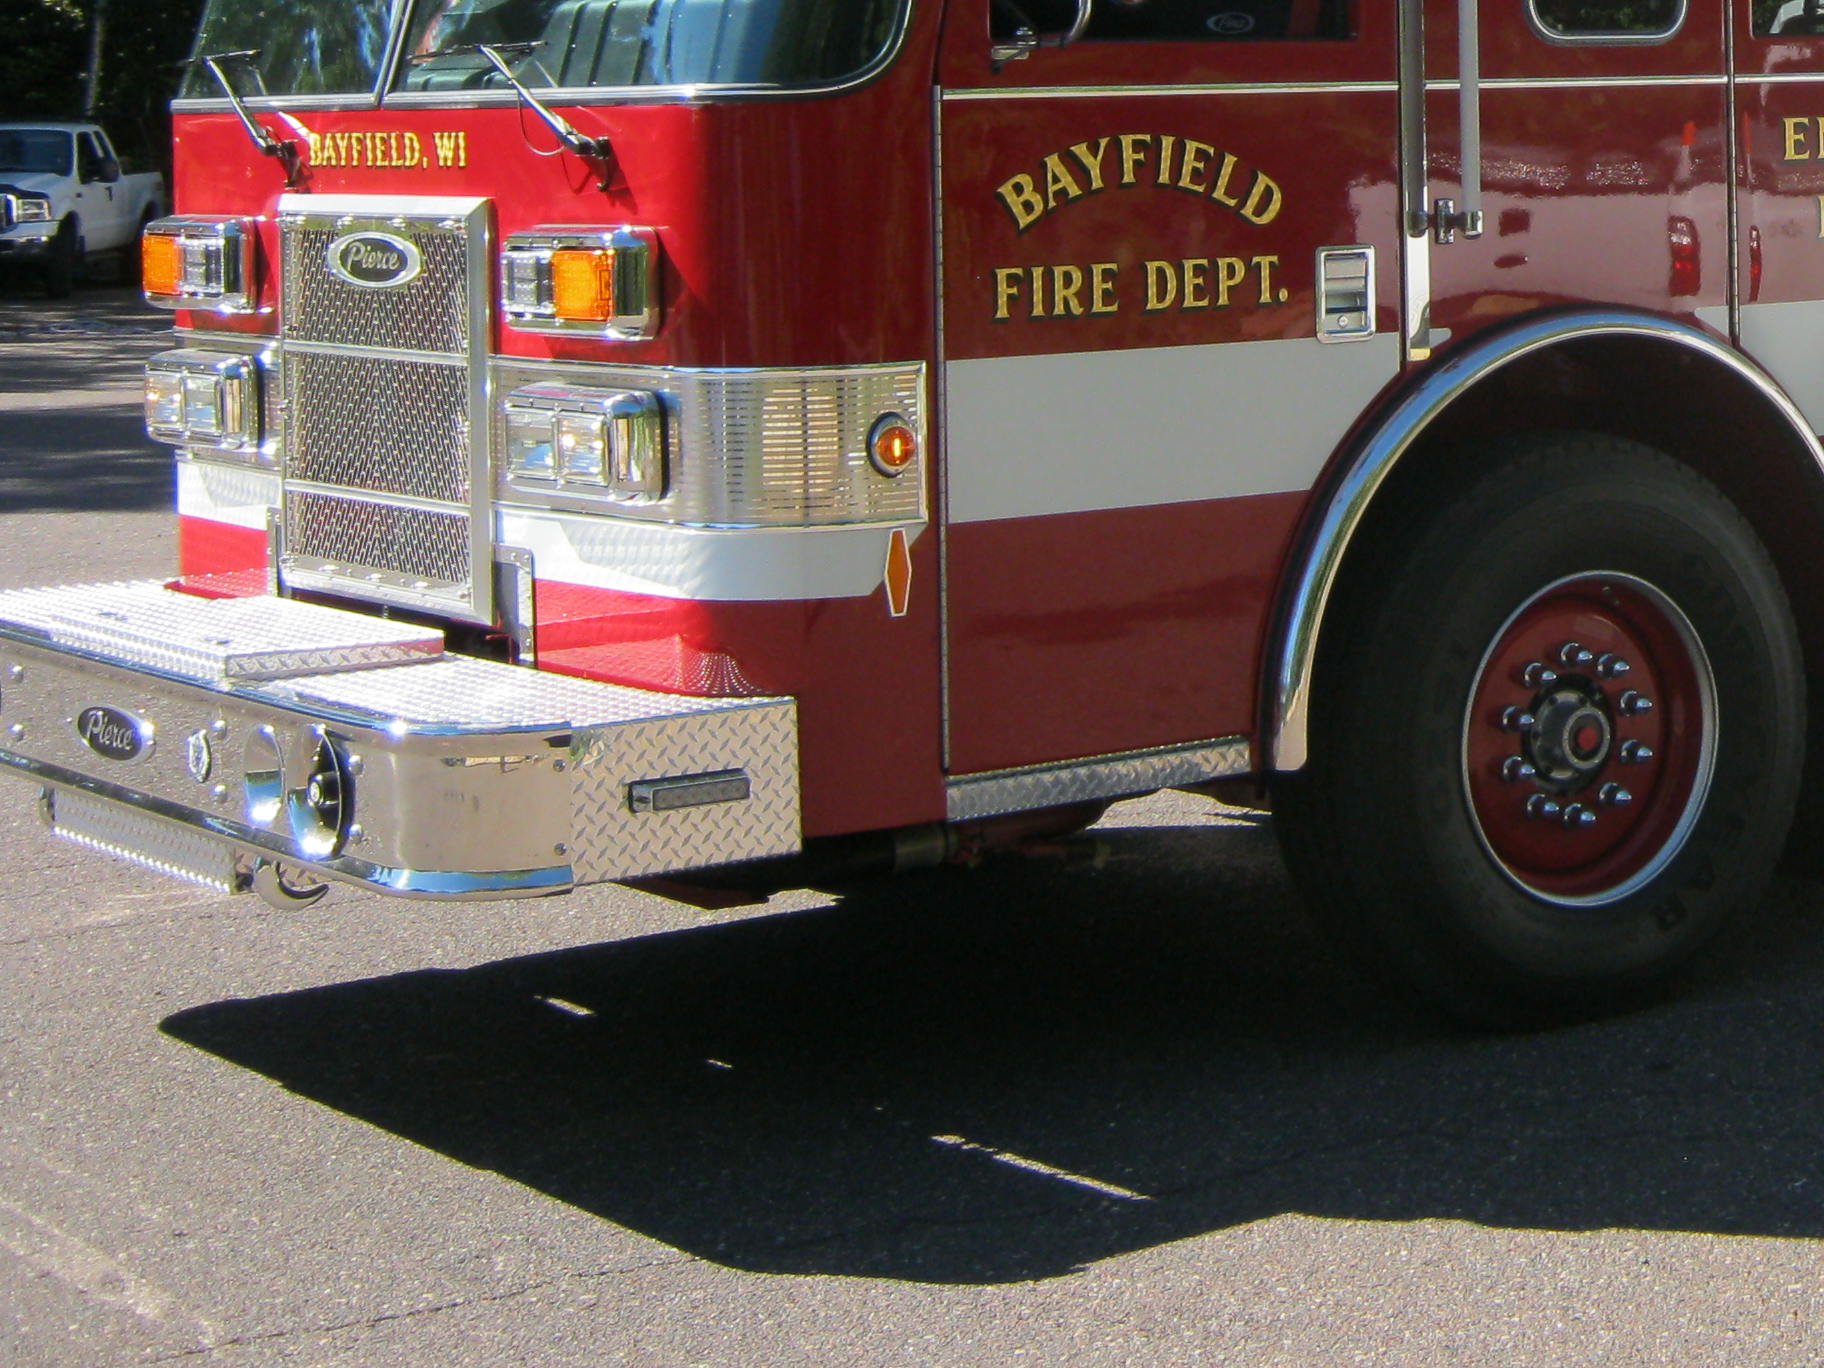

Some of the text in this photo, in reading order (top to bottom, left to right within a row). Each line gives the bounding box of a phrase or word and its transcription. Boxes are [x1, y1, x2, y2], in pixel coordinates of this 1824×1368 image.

[308, 131, 467, 170] BAYFIELD, WI
[995, 133, 1283, 231] BAYFIELD
[344, 241, 401, 272] Pierce
[993, 254, 1289, 319] FIRE DEPT.
[86, 710, 134, 751] Pierce
